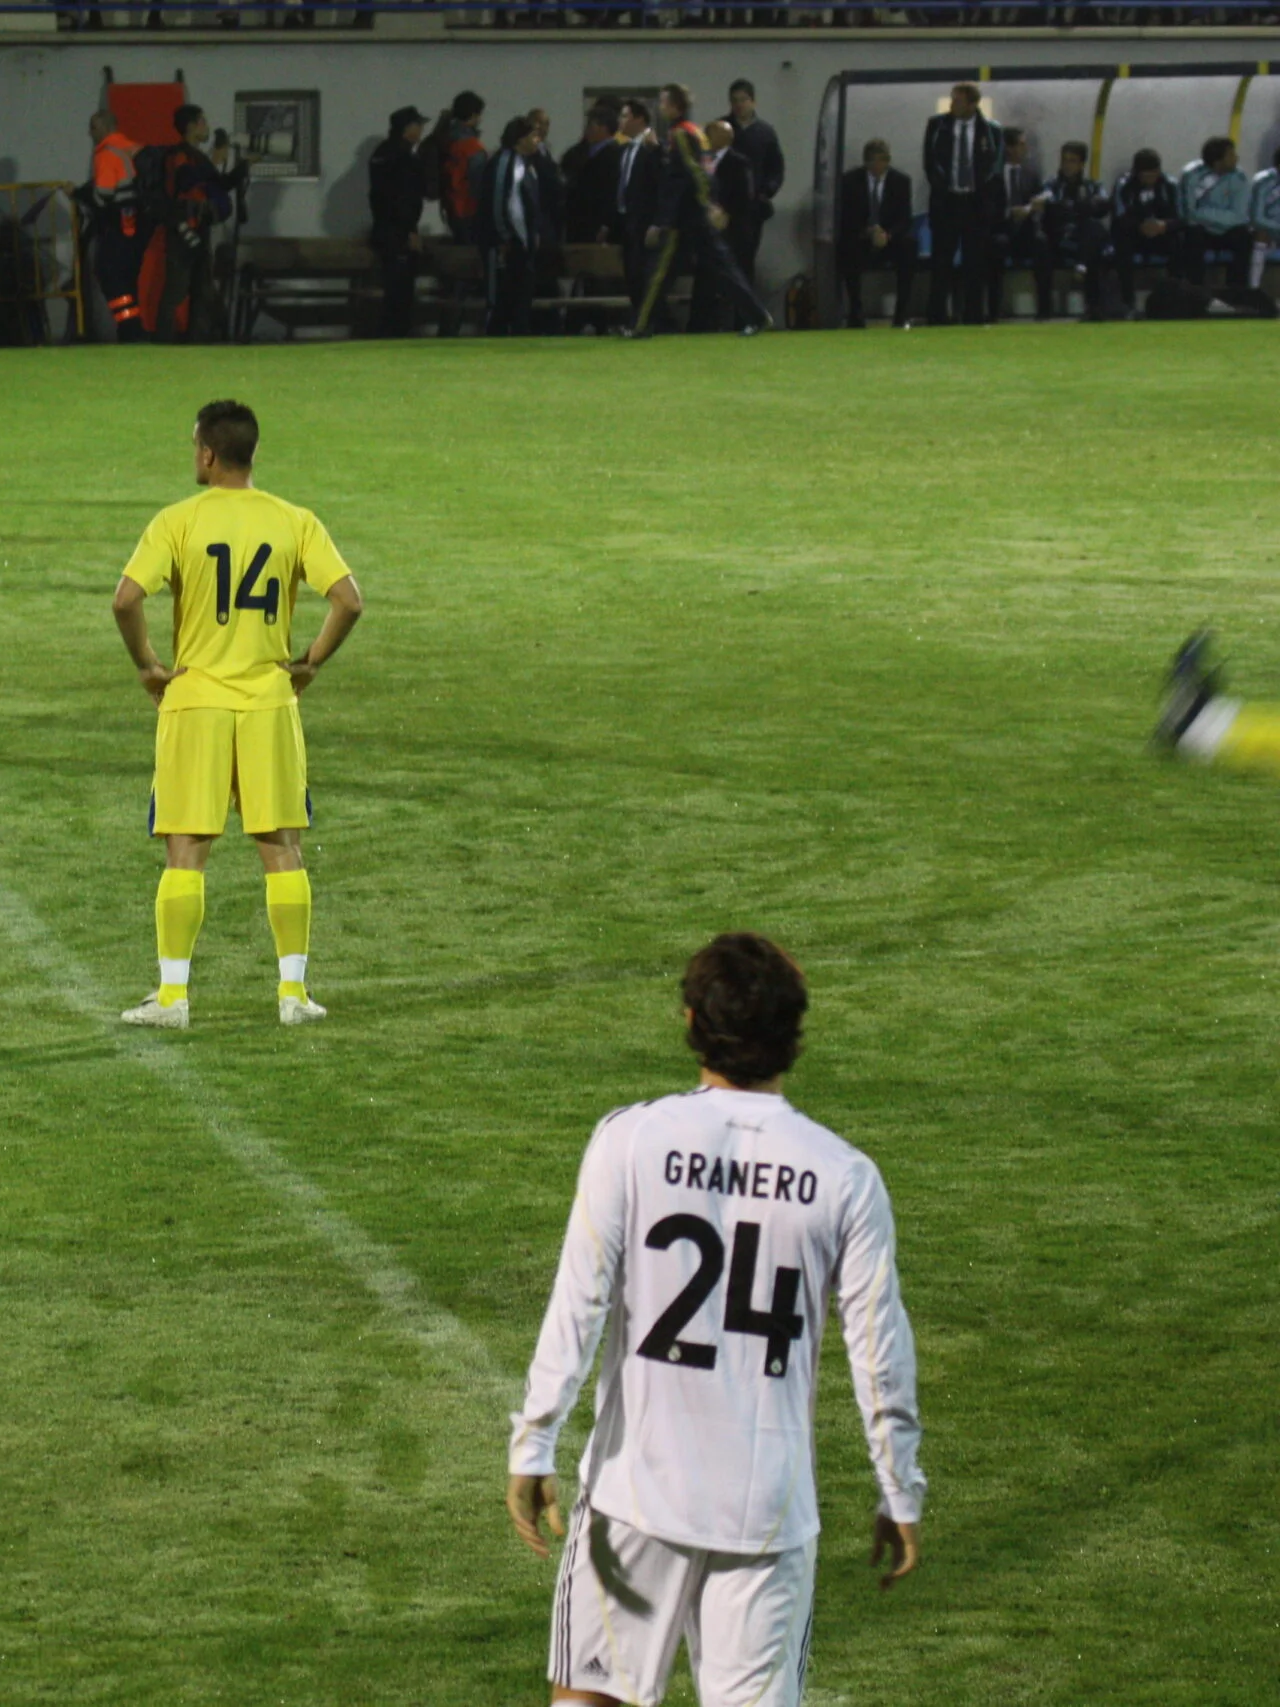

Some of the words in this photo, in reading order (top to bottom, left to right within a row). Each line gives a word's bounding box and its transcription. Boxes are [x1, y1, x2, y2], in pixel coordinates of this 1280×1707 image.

[205, 542, 280, 626] 14
[664, 1150, 818, 1205] GRANERO
[636, 1212, 805, 1379] 24
